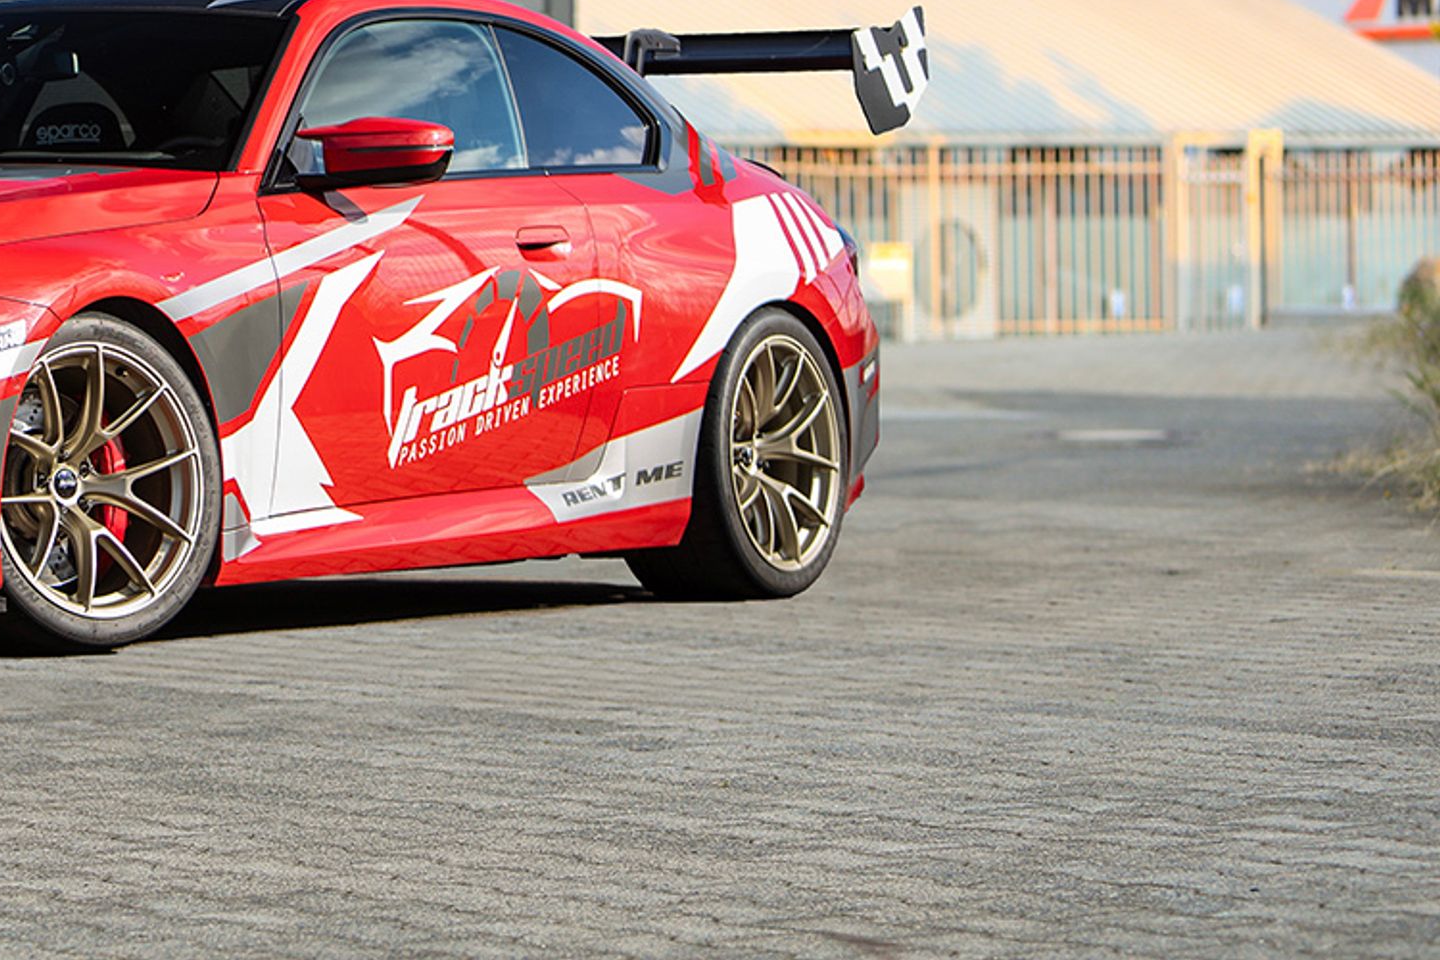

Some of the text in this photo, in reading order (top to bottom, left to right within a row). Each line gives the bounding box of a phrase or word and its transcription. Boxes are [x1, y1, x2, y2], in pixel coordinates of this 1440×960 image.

[397, 355, 621, 466] PASSION DRIVEN EXPERIENCE
[561, 460, 684, 507] RENT ME
